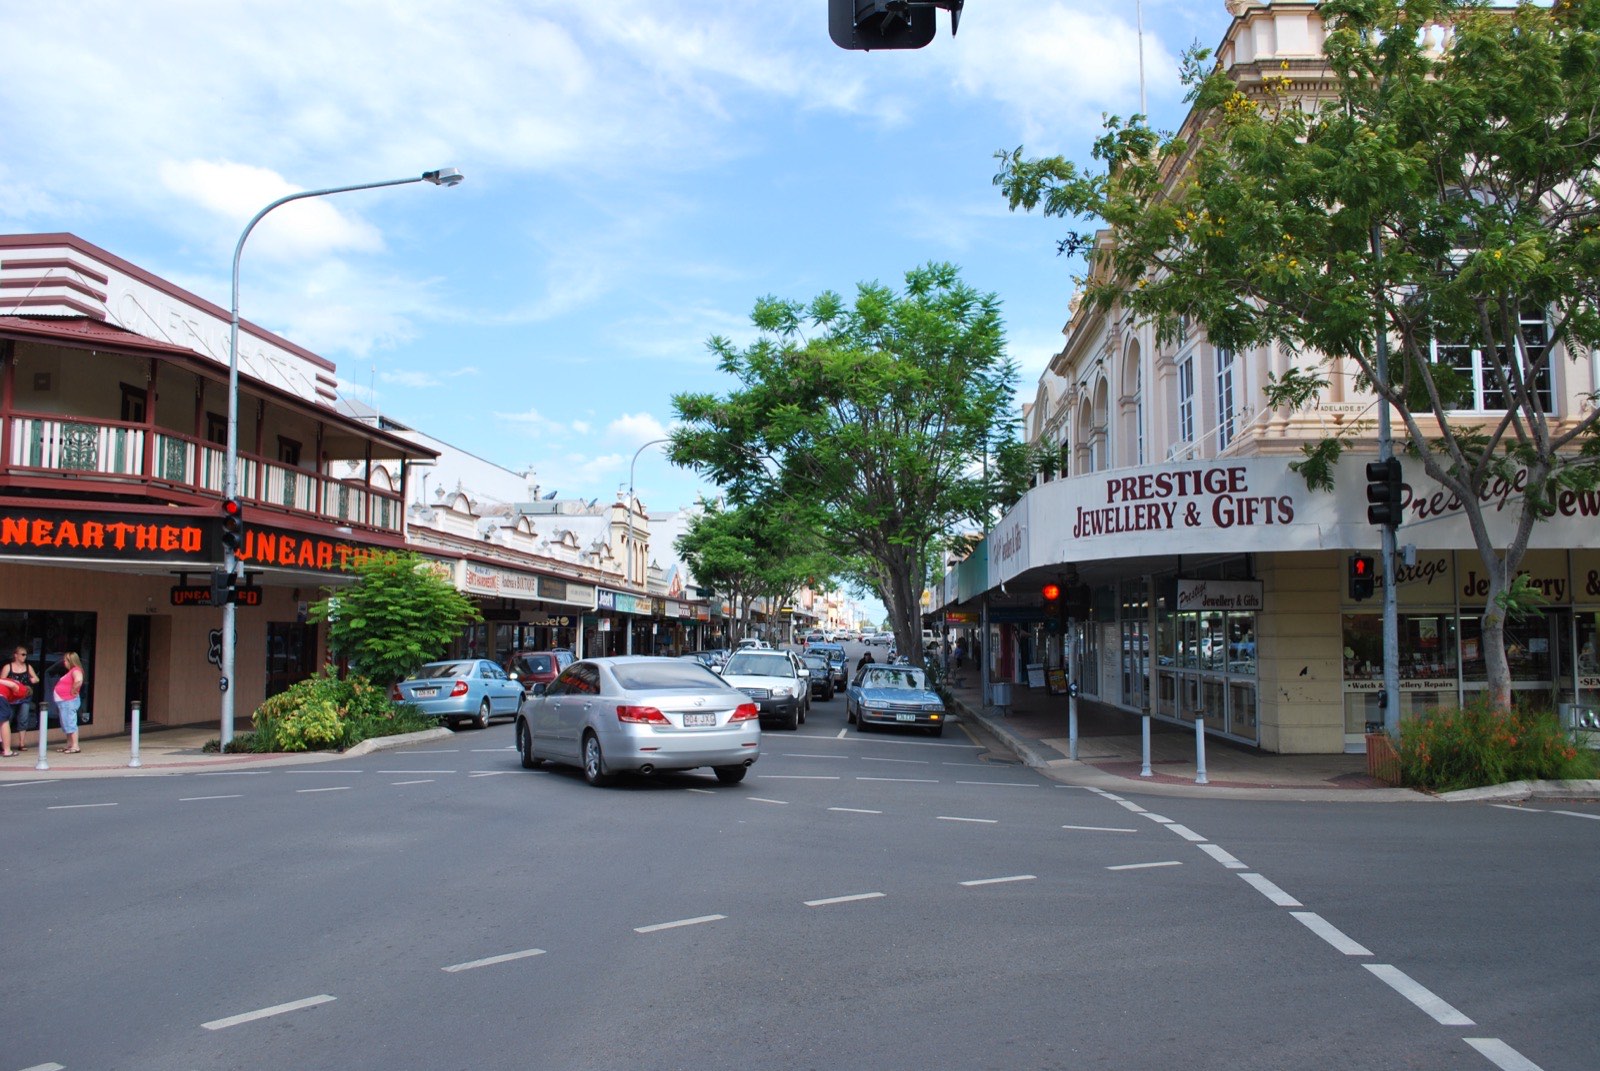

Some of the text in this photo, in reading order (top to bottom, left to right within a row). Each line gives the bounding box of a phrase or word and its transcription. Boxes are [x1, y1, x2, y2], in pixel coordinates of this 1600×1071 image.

[1106, 466, 1249, 504] PRESTIGE
[1073, 494, 1294, 539] JEWELLERY & GIFTS
[1202, 594, 1259, 608] Jewellery & Gifts
[1424, 681, 1453, 690] Repairs
